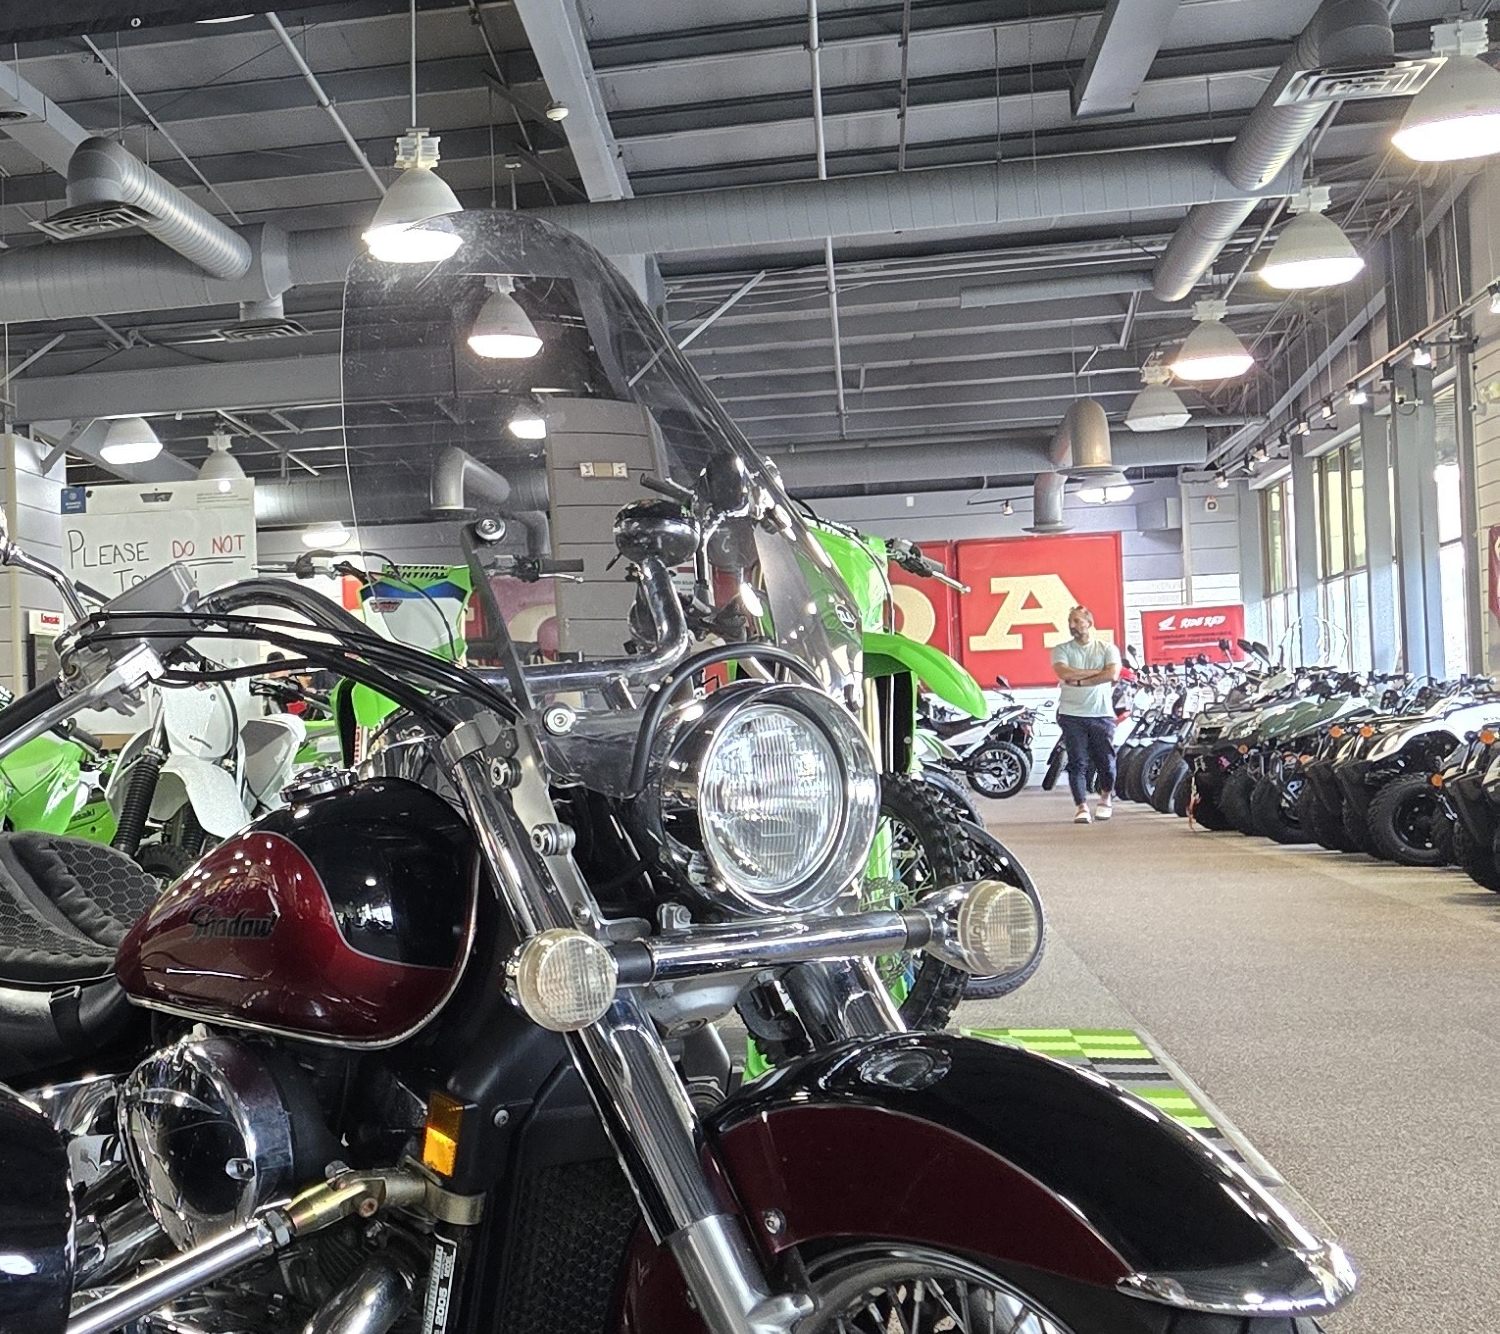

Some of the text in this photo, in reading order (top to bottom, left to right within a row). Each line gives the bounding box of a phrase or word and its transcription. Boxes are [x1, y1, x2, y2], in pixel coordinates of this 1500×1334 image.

[67, 529, 246, 570] PLEASE DO NOT
[188, 904, 278, 942] Shadow
